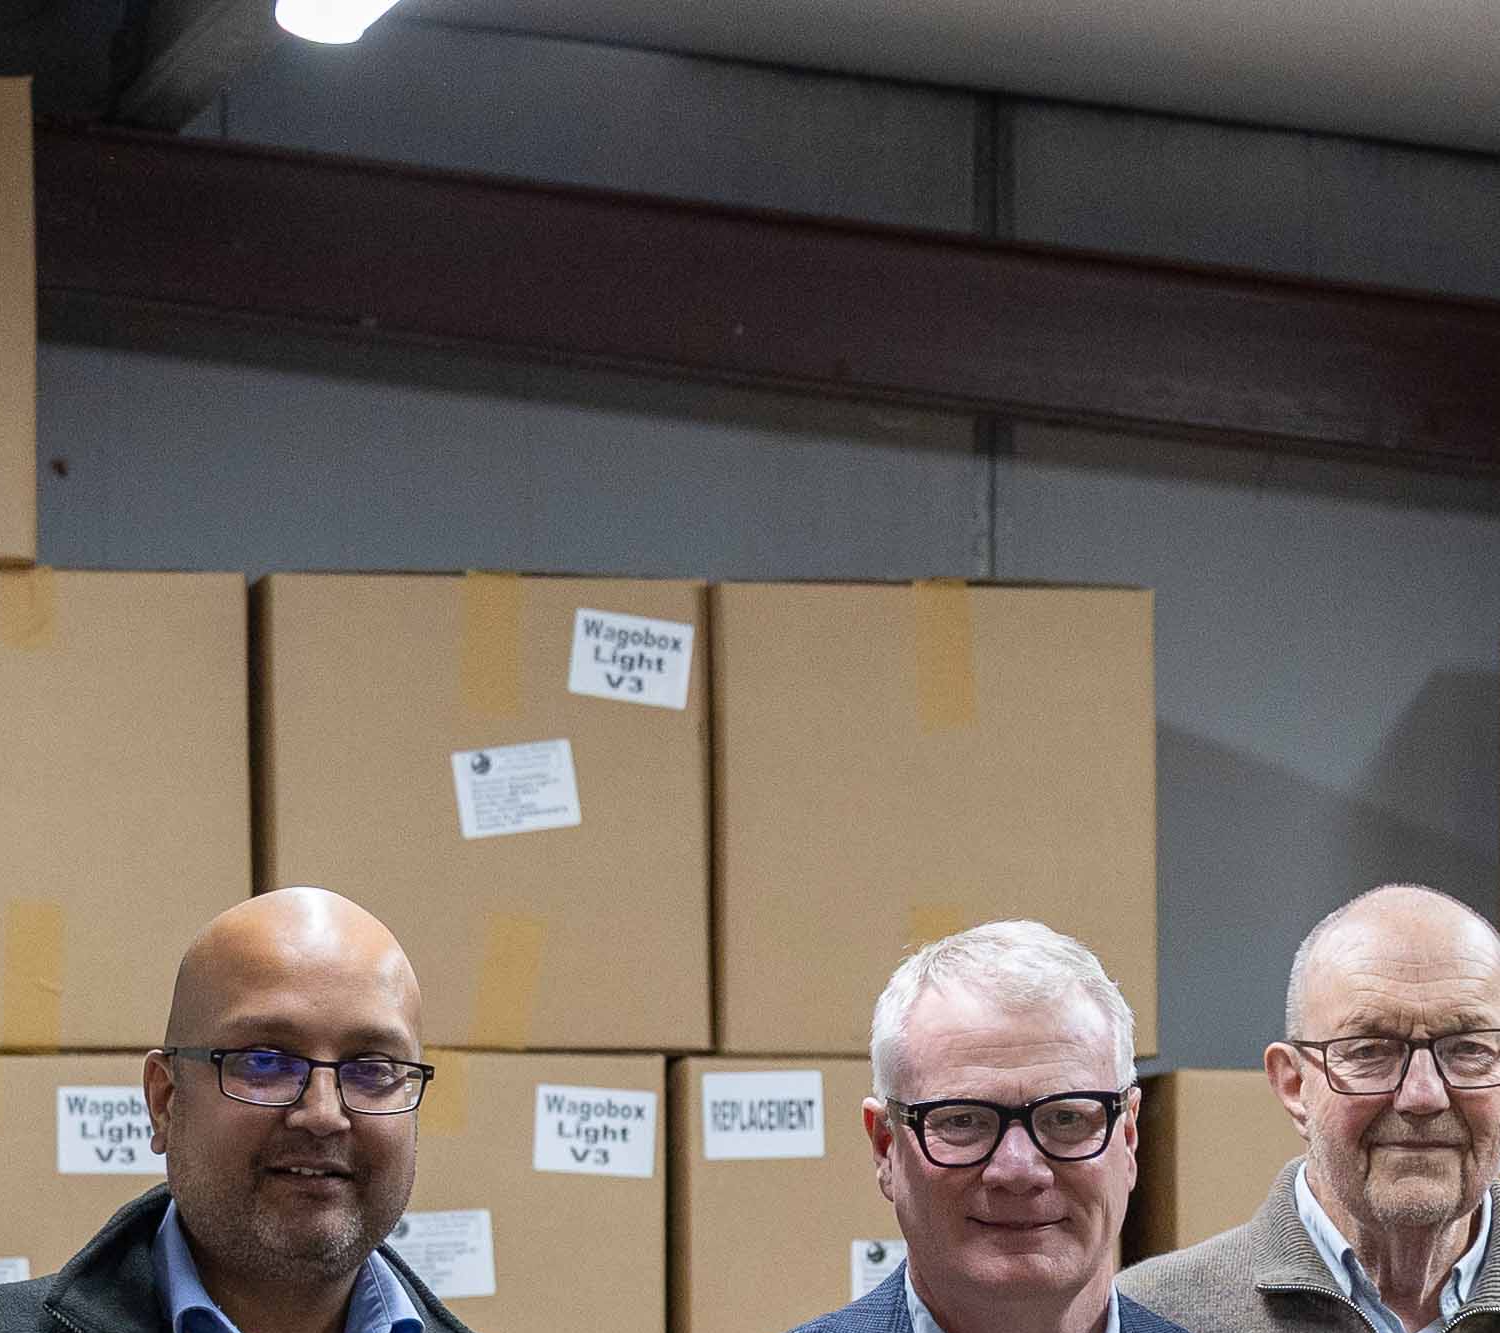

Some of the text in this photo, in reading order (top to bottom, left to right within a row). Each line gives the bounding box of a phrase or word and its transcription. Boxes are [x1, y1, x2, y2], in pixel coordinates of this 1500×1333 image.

[584, 618, 683, 653] Wagobox
[593, 646, 666, 674] Light
[605, 672, 644, 694] V3
[67, 1096, 148, 1121] Wagob
[543, 1093, 646, 1123] Wagobox
[711, 1098, 816, 1133] REPLACEMENT
[80, 1120, 152, 1142] Light
[556, 1120, 632, 1144] Light
[94, 1146, 136, 1164] V3
[570, 1144, 611, 1166] V3
